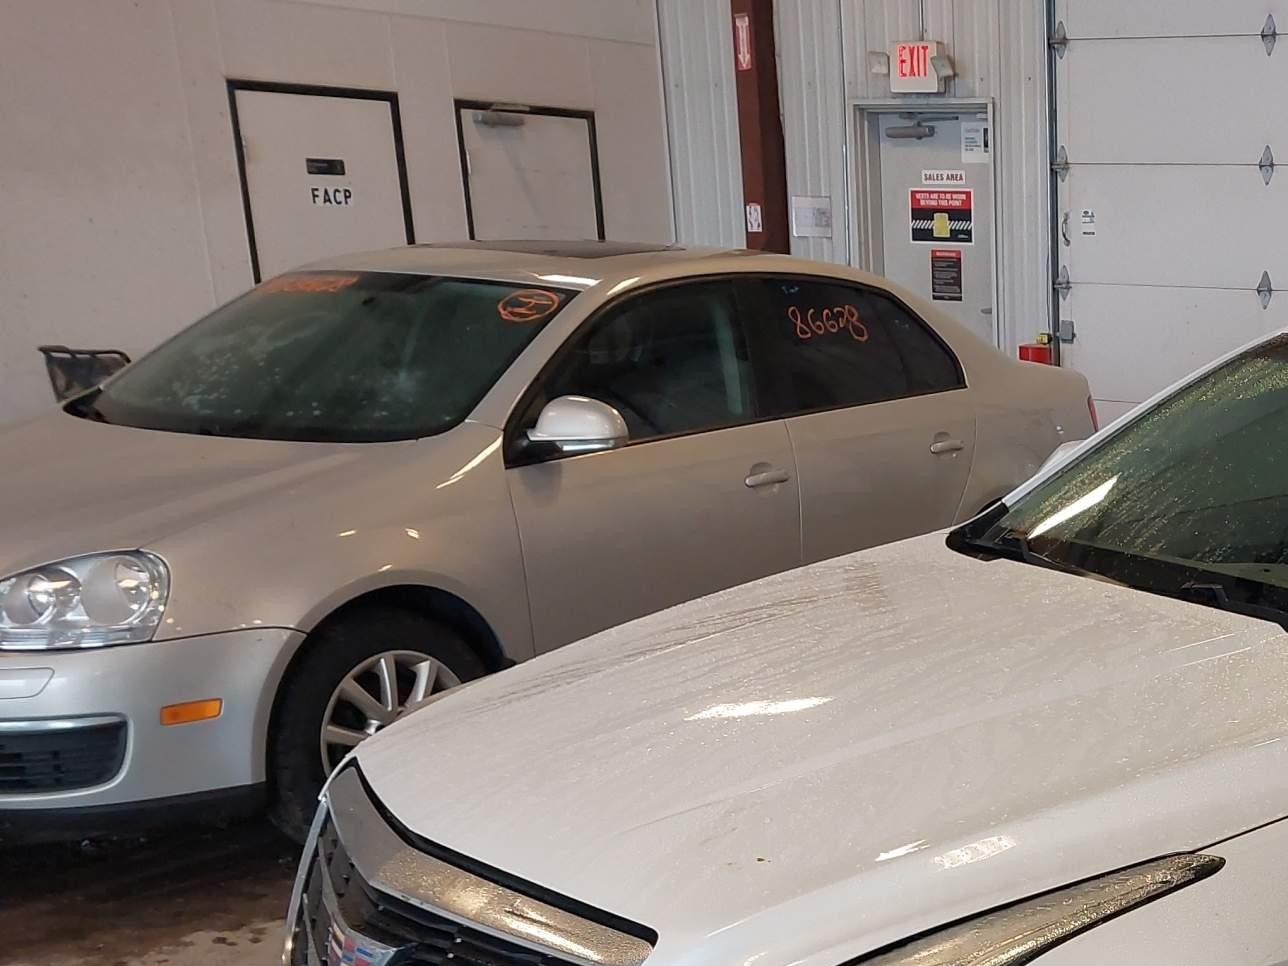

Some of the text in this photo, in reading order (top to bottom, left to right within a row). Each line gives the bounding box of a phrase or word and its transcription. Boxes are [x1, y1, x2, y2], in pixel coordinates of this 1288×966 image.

[898, 45, 929, 77] EXIT
[923, 173, 964, 182] SALES AREA
[311, 187, 352, 205] FACP
